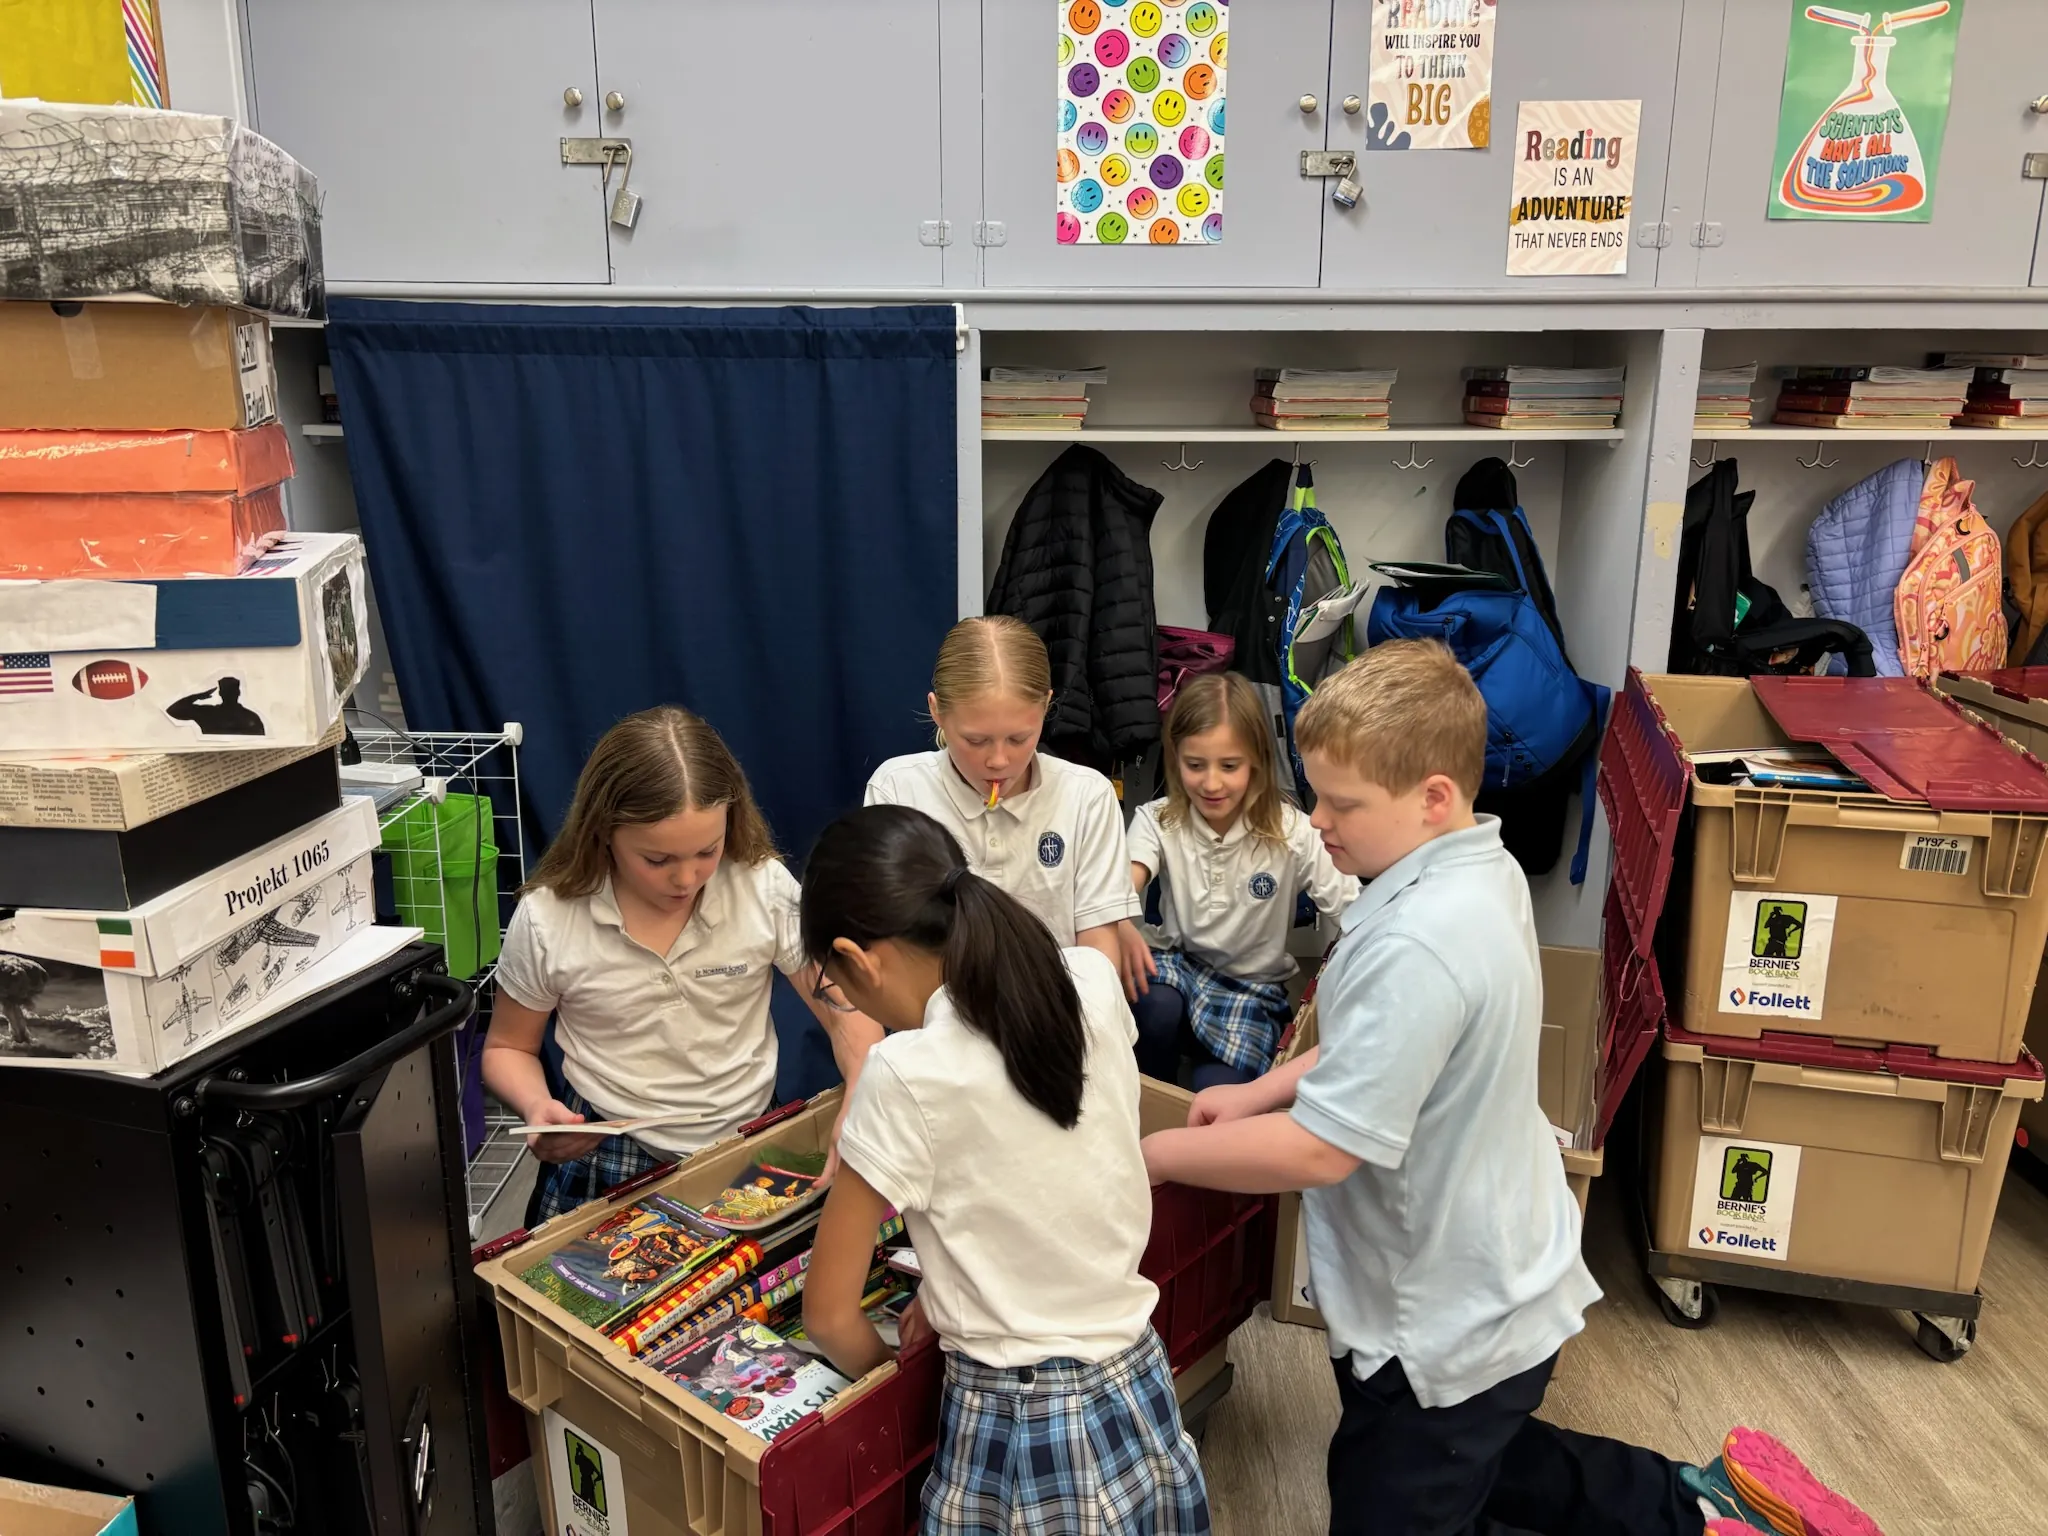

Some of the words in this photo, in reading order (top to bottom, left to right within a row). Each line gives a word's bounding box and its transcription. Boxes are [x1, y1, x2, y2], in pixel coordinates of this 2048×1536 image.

[1387, 0, 1480, 28] READING
[1385, 34, 1410, 49] WILL
[1412, 34, 1457, 49] INSPIRE
[1459, 33, 1481, 48] YOU
[1395, 55, 1414, 79] TO
[1419, 54, 1467, 79] THINK
[1405, 83, 1452, 126] BIG
[1819, 108, 1904, 140] SCIENTISTS
[1524, 128, 1622, 169] Reading
[1820, 136, 1863, 163] HAVE
[1866, 134, 1892, 158] ALL
[1554, 167, 1568, 186] IS
[1572, 167, 1594, 186] AN
[1806, 156, 1834, 190] THE
[1835, 155, 1909, 190] SOLUTIONS
[1517, 196, 1626, 221] ADVENTURE
[1515, 233, 1545, 248] THAT
[1547, 232, 1587, 248] NEVER
[1590, 232, 1623, 248] ENDS
[1917, 836, 1959, 849] PY97-6
[224, 863, 290, 917] Projekt
[292, 838, 330, 878] 1065
[1748, 967, 1773, 977] BOOK
[1774, 969, 1800, 978] BANK
[1749, 958, 1800, 971] BERNIE'S
[1748, 991, 1812, 1010] Follett
[1716, 1209, 1741, 1218] BOOK
[1742, 1212, 1766, 1221] BANK
[1717, 1200, 1766, 1214] BERNIE'S
[1716, 1230, 1777, 1251] Follett
[572, 1494, 610, 1531] BERNIE'S
